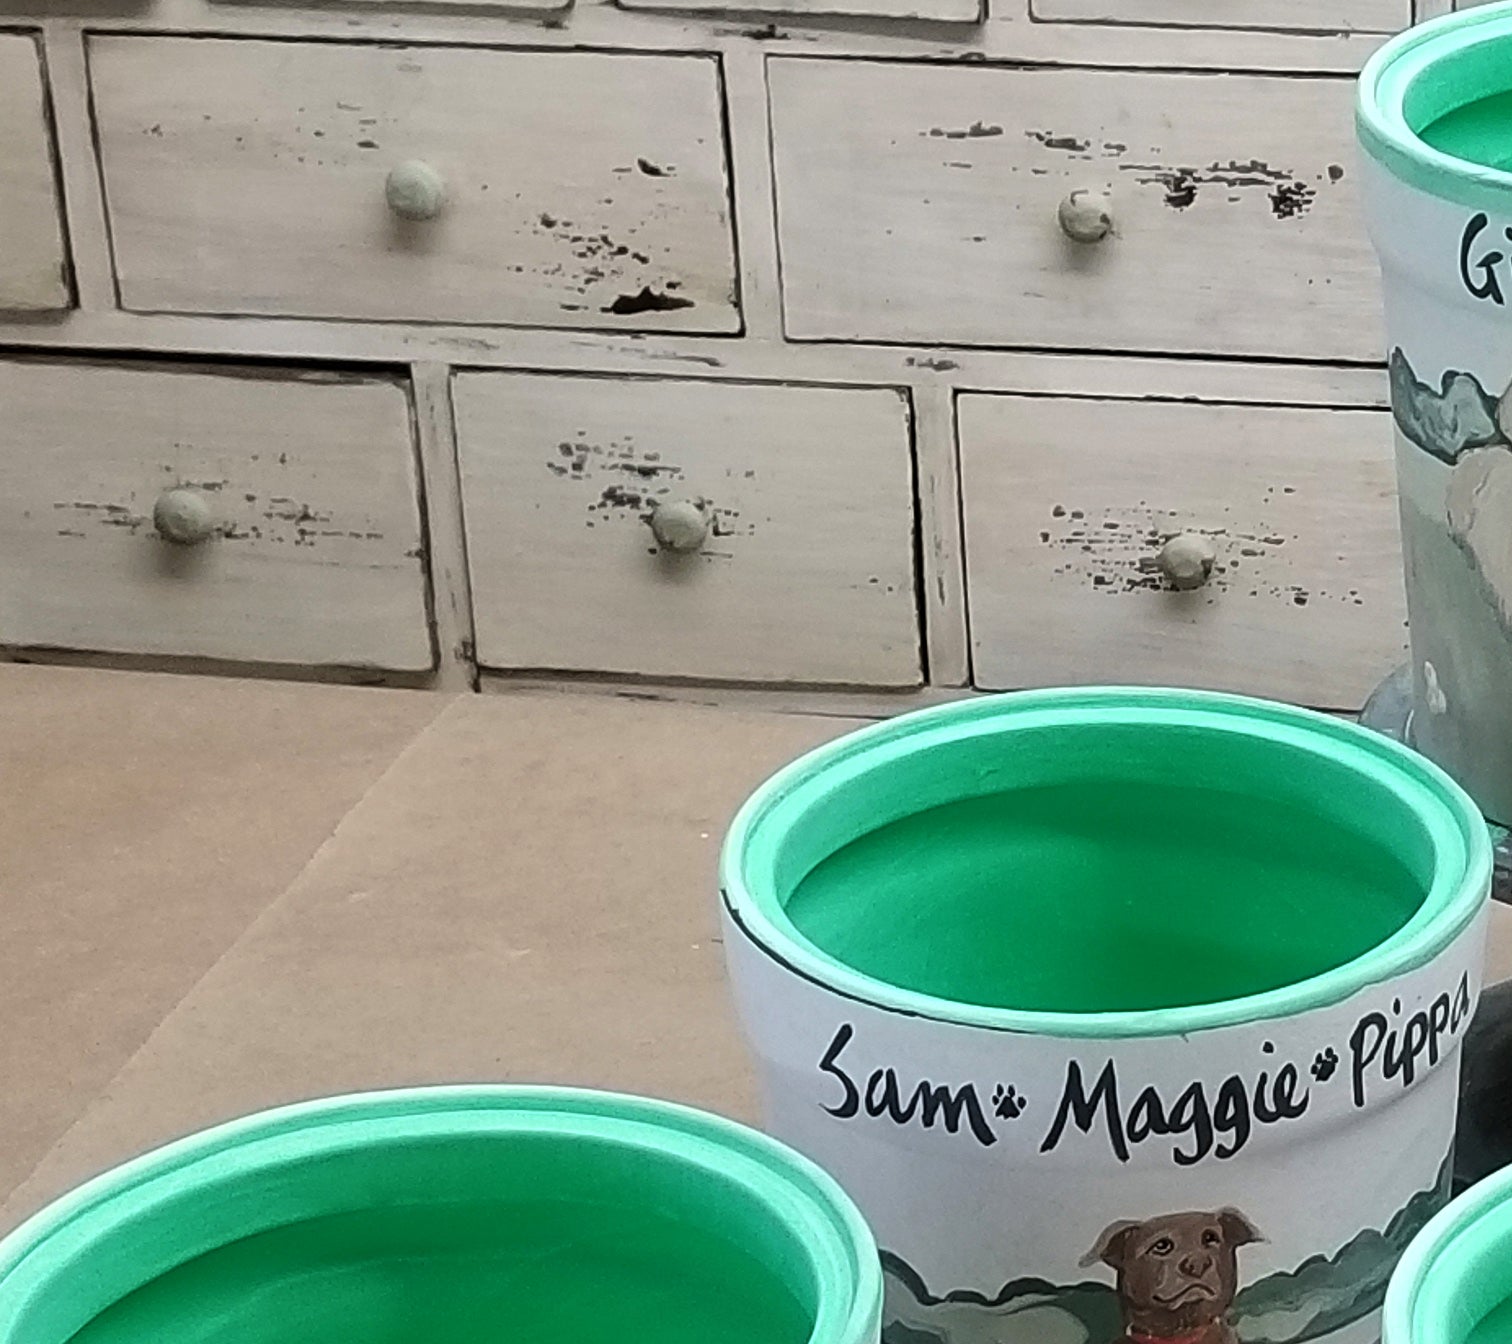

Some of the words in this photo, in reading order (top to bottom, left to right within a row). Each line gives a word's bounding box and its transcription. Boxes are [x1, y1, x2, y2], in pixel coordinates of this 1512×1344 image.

[819, 1024, 997, 1147] Sam
[1039, 1041, 1309, 1166] Maggie
[1349, 970, 1470, 1108] Pippa
